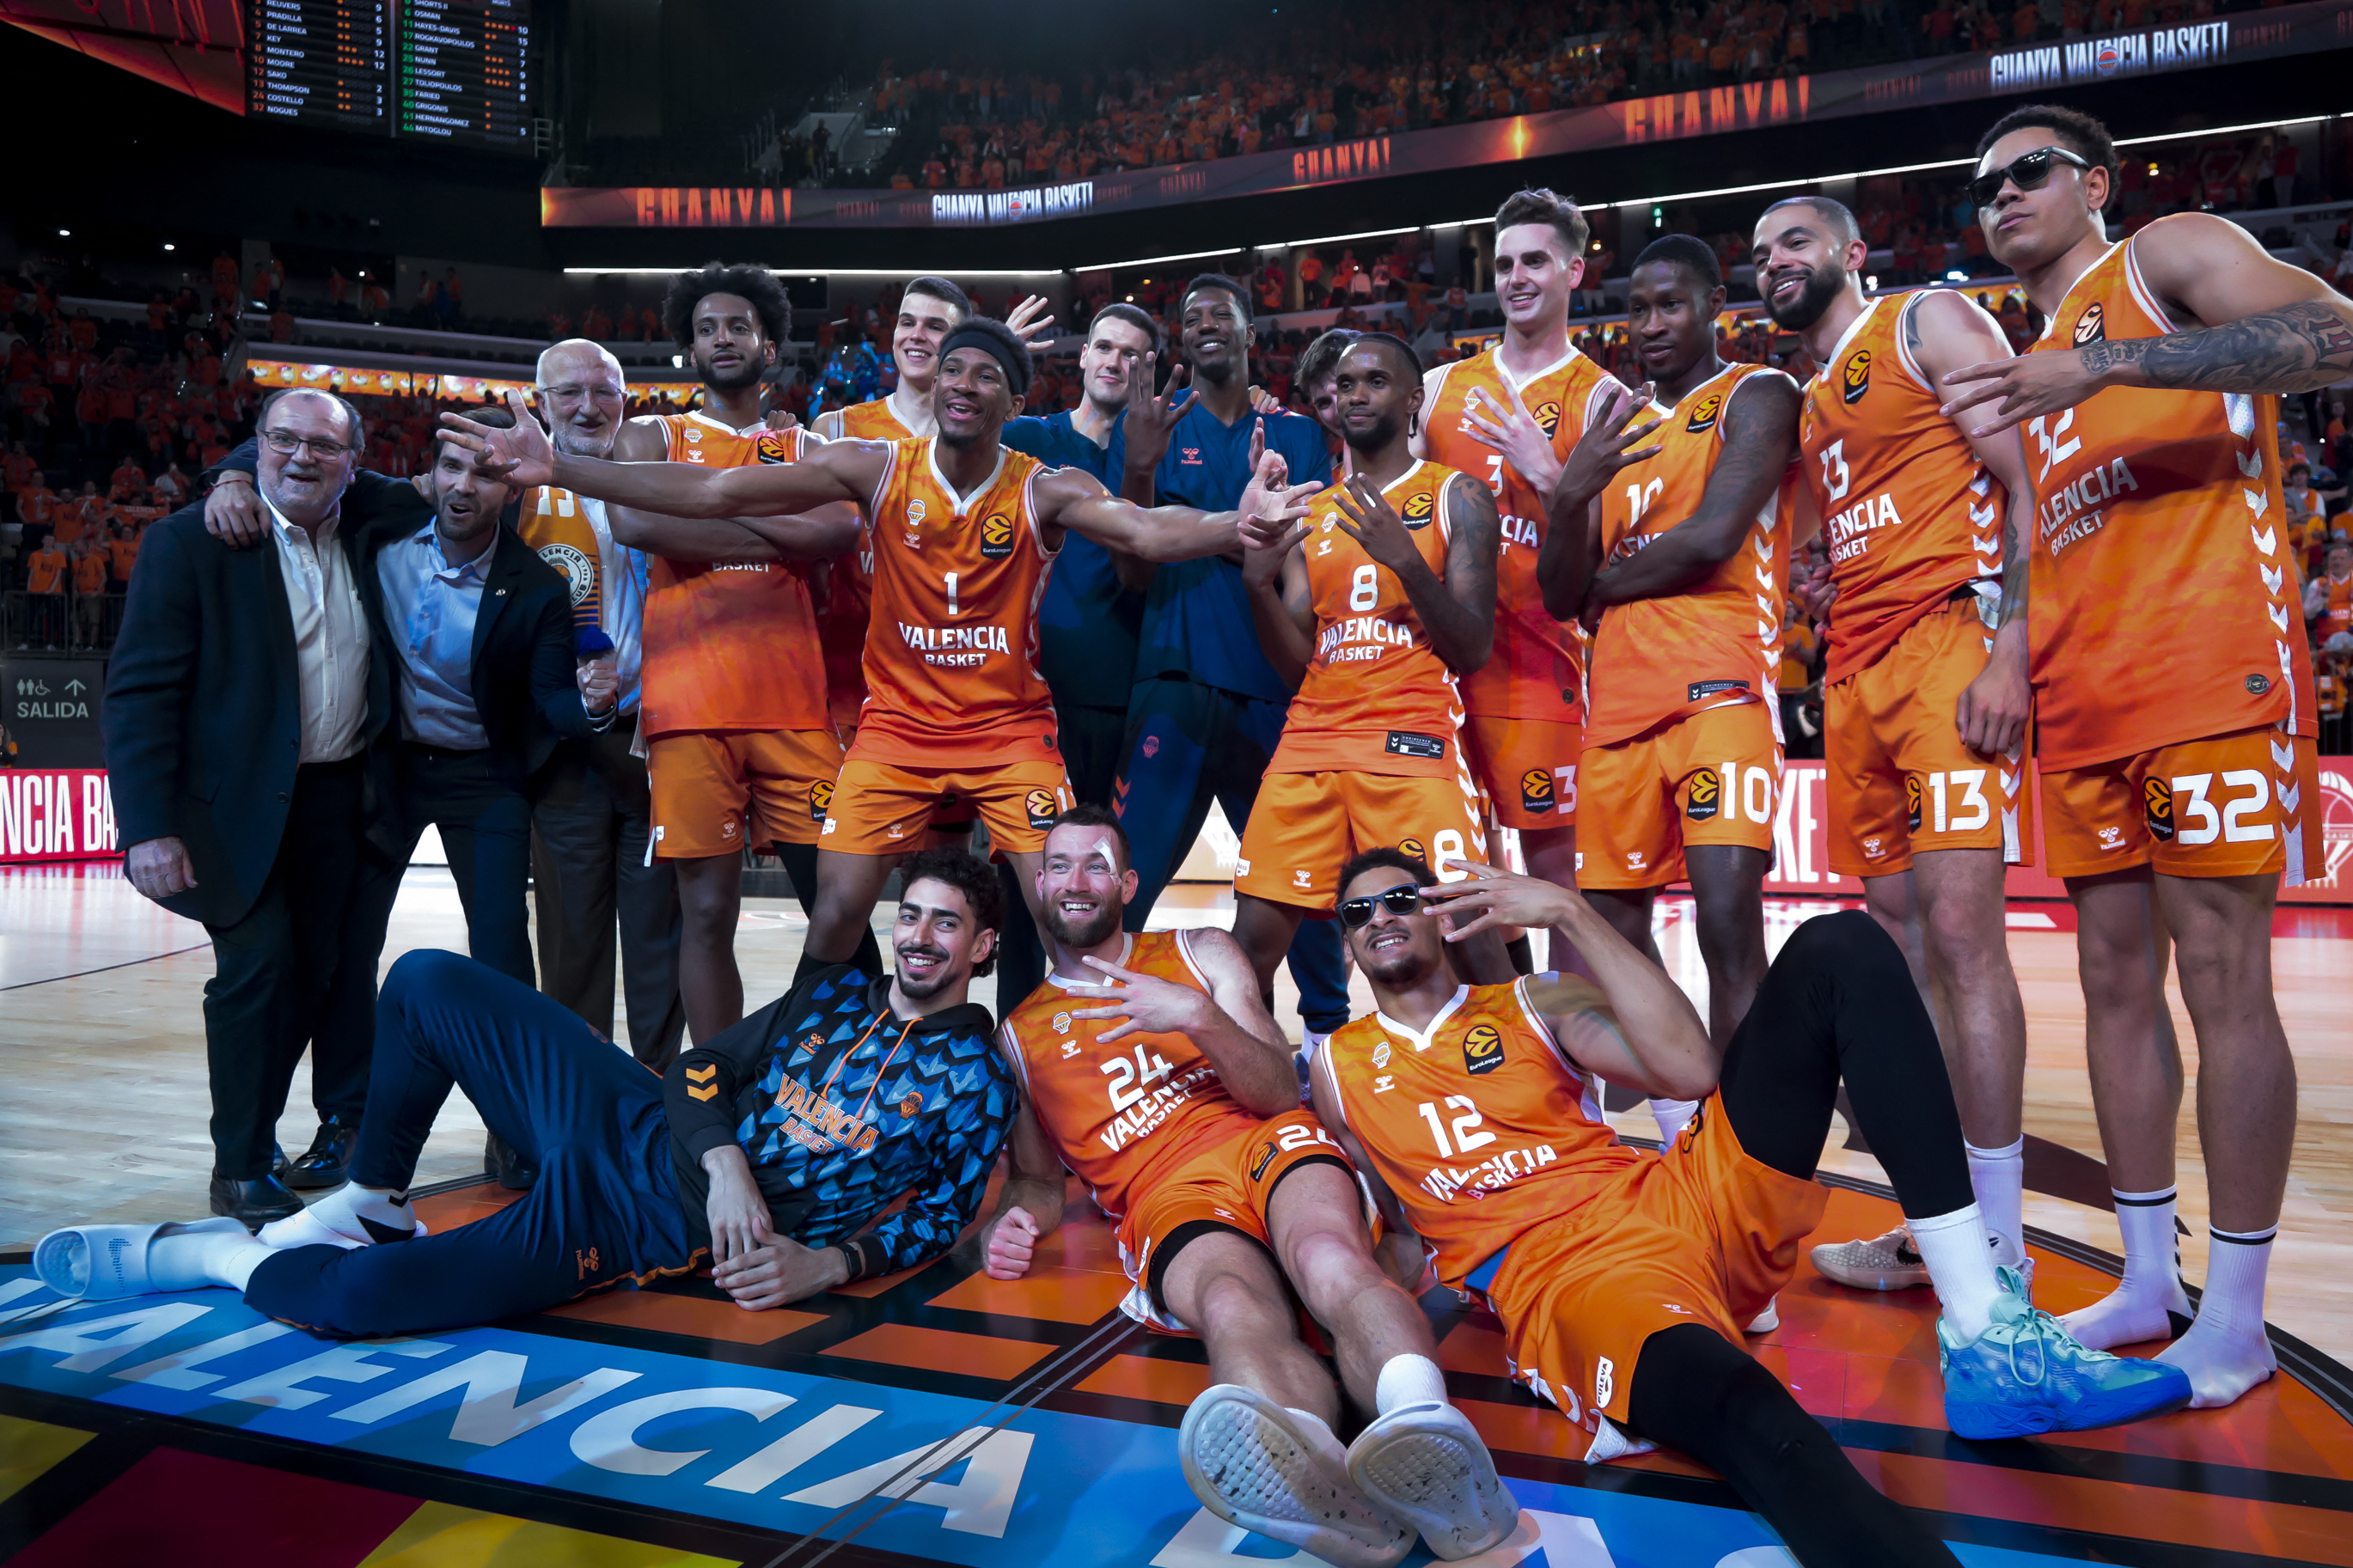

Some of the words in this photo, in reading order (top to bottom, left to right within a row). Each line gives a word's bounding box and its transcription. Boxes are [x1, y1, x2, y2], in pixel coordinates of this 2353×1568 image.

[266, 0, 301, 11] REUVERS
[376, 15, 382, 24] 6
[266, 10, 303, 22] PRADILLA
[376, 27, 382, 35] 5
[414, 10, 441, 20] OSMAN
[517, 27, 529, 35] 10
[266, 22, 278, 31] DE
[278, 24, 308, 35] LARREA
[376, 39, 382, 47] 9
[402, 20, 413, 28] 11
[414, 21, 461, 34] HAYES-DAVIS
[517, 38, 529, 46] 15
[414, 33, 475, 49] ROGKAVOPOULOS
[266, 34, 282, 43] KEY
[374, 50, 385, 58] 12
[266, 46, 304, 58] MONTERO
[374, 62, 385, 70] 12
[414, 44, 439, 54] GRANT
[254, 56, 265, 64] 10
[266, 58, 296, 69] MOORE
[402, 54, 413, 63] 25
[414, 56, 437, 65] NUNN
[402, 65, 413, 74] 26
[414, 68, 446, 77] LESSORT
[266, 70, 288, 79] SAKO
[414, 79, 462, 92] TOLIOPOULOS
[253, 90, 265, 100] 24
[267, 94, 304, 105] COSTELLO
[267, 82, 310, 95] THOMPSON
[414, 90, 441, 101] FARIED
[267, 106, 298, 117] NOGUES
[402, 101, 414, 109] 40
[415, 102, 449, 113] GRIGONIS
[402, 112, 413, 120] 41
[415, 113, 470, 127] HERNANGOMEZ
[415, 125, 452, 137] MITOGLOU
[2028, 407, 2082, 485] 32
[1486, 455, 1504, 498] 3
[1819, 438, 1850, 504] 13
[2040, 456, 2139, 545] ALENCIA
[1827, 492, 1902, 545] ENCIA
[1499, 514, 1538, 548] CIA
[2050, 509, 2104, 558] BASKET
[712, 560, 770, 573] BASKET
[944, 571, 959, 615] 1
[1349, 564, 1378, 612] 8
[898, 621, 1011, 656] VALENCIA
[1320, 616, 1414, 655] VALENCIA
[925, 652, 987, 667] BASKET
[1329, 645, 1384, 664] BASKET
[17, 701, 89, 718] SALIDA
[1554, 764, 1577, 815] 3
[1720, 761, 1772, 825] 10
[1928, 769, 1990, 833] 13
[0, 775, 75, 856] NCIA
[1688, 806, 1716, 815] EuroLeague
[2171, 768, 2276, 845] 32
[1433, 828, 1469, 884] 8
[2100, 839, 2125, 851] hummel
[1628, 862, 1647, 870] hummel
[1470, 1055, 1502, 1071] EuroLeague
[1099, 1043, 1175, 1113] 24
[1374, 1083, 1395, 1094] hummel
[773, 1072, 879, 1154] VALENCIA
[779, 1116, 835, 1156] BASKET
[1419, 1094, 1498, 1159] 12
[1275, 1124, 1348, 1157] 24
